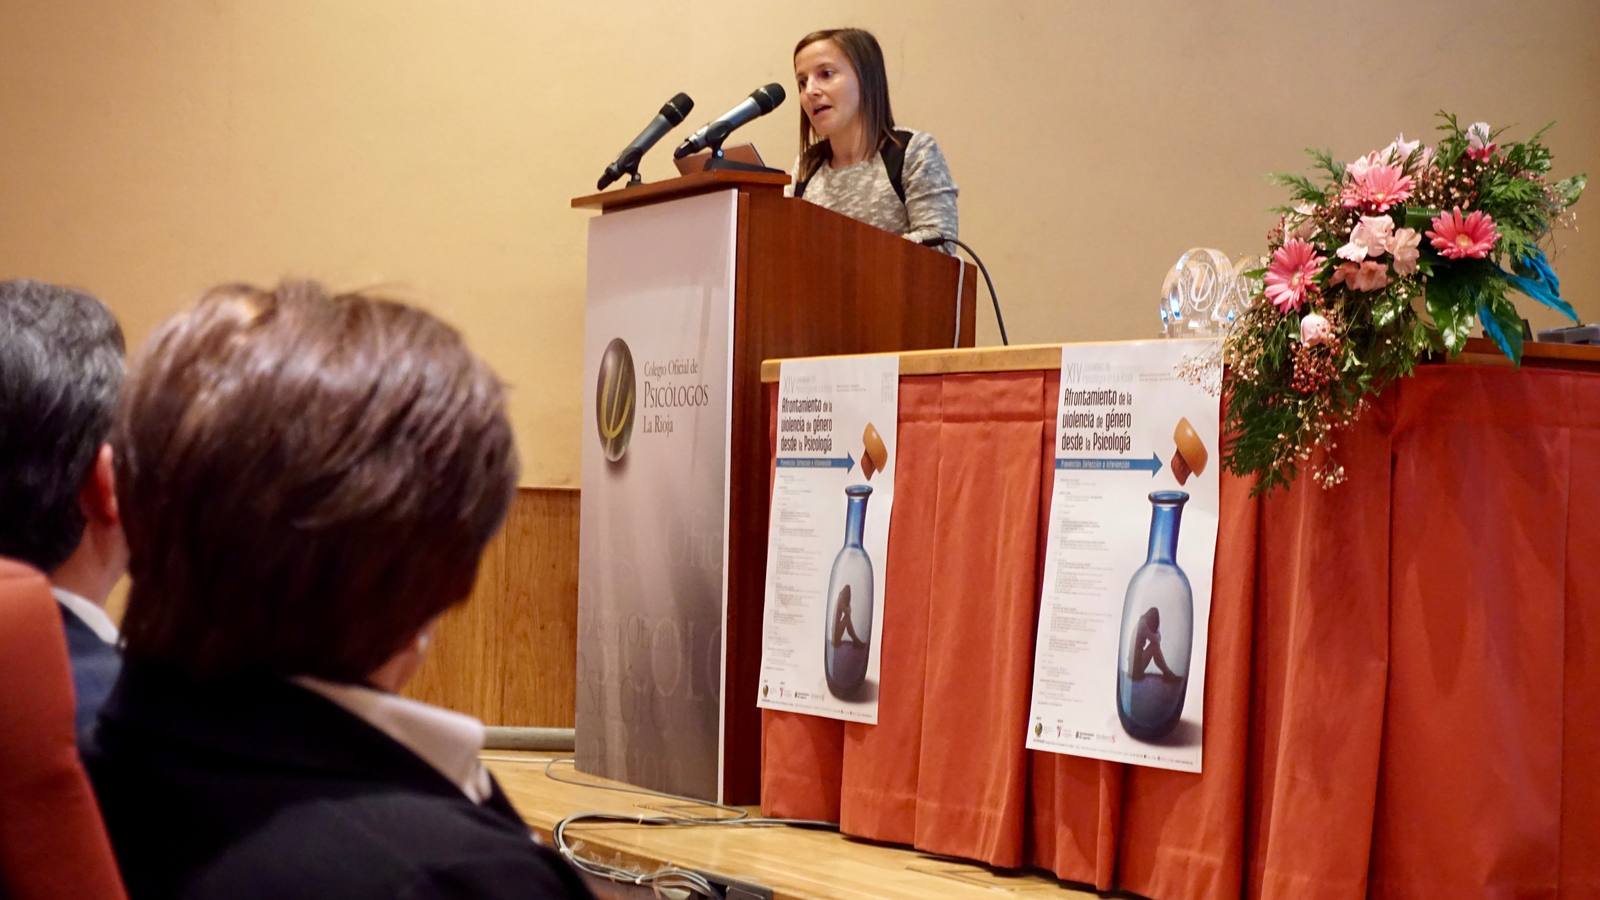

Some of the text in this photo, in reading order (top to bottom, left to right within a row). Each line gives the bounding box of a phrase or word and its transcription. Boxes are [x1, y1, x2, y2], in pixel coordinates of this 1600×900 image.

[644, 359, 699, 380] Colegio Oficial de
[644, 381, 709, 408] PSICÓLOGOS
[1064, 388, 1132, 406] Afrontamiento de la
[782, 398, 822, 413] Afrontamiento
[823, 402, 829, 412] de
[643, 414, 674, 437] La Rioja
[781, 416, 805, 432] violencia
[813, 415, 833, 435] género
[1063, 408, 1132, 431] violencia de género
[781, 435, 798, 451] desde
[804, 434, 833, 454] Psicología
[1062, 431, 1131, 454] desde la Psicología
